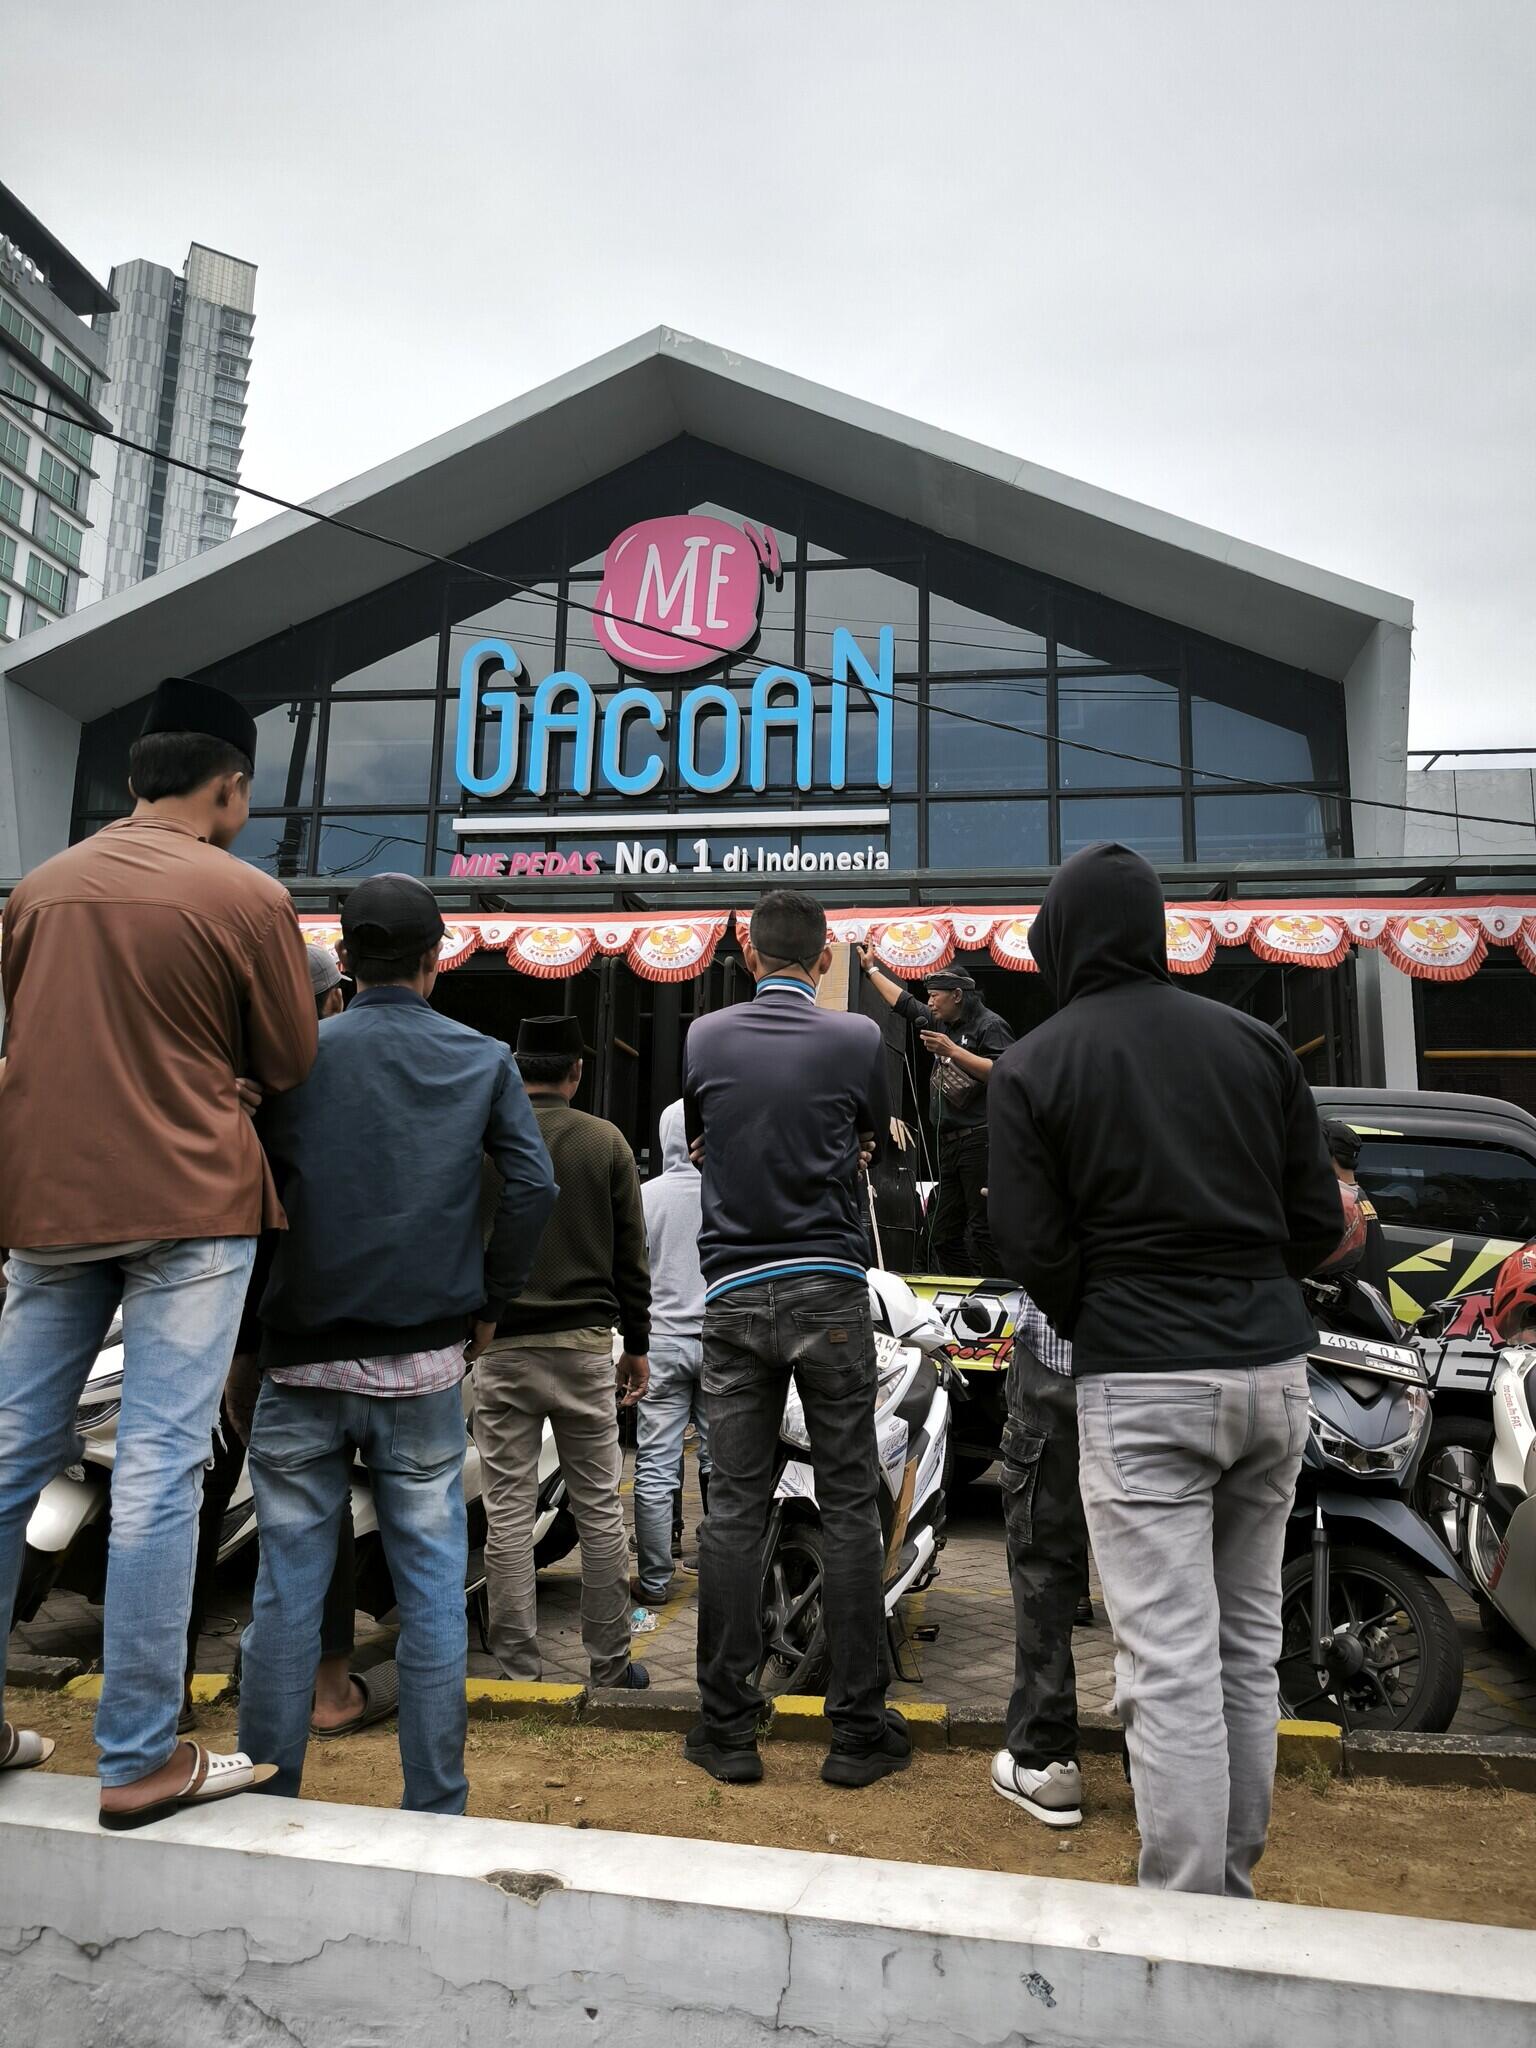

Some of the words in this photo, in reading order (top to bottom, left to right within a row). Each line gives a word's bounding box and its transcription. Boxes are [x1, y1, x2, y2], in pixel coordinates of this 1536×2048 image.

[455, 625, 895, 797] GACOAN
[450, 852, 508, 876] MIE
[508, 851, 602, 876] PEDAS
[615, 841, 680, 875] No.
[692, 838, 713, 873] 1
[722, 845, 749, 872] di
[757, 844, 890, 872] Indonesia
